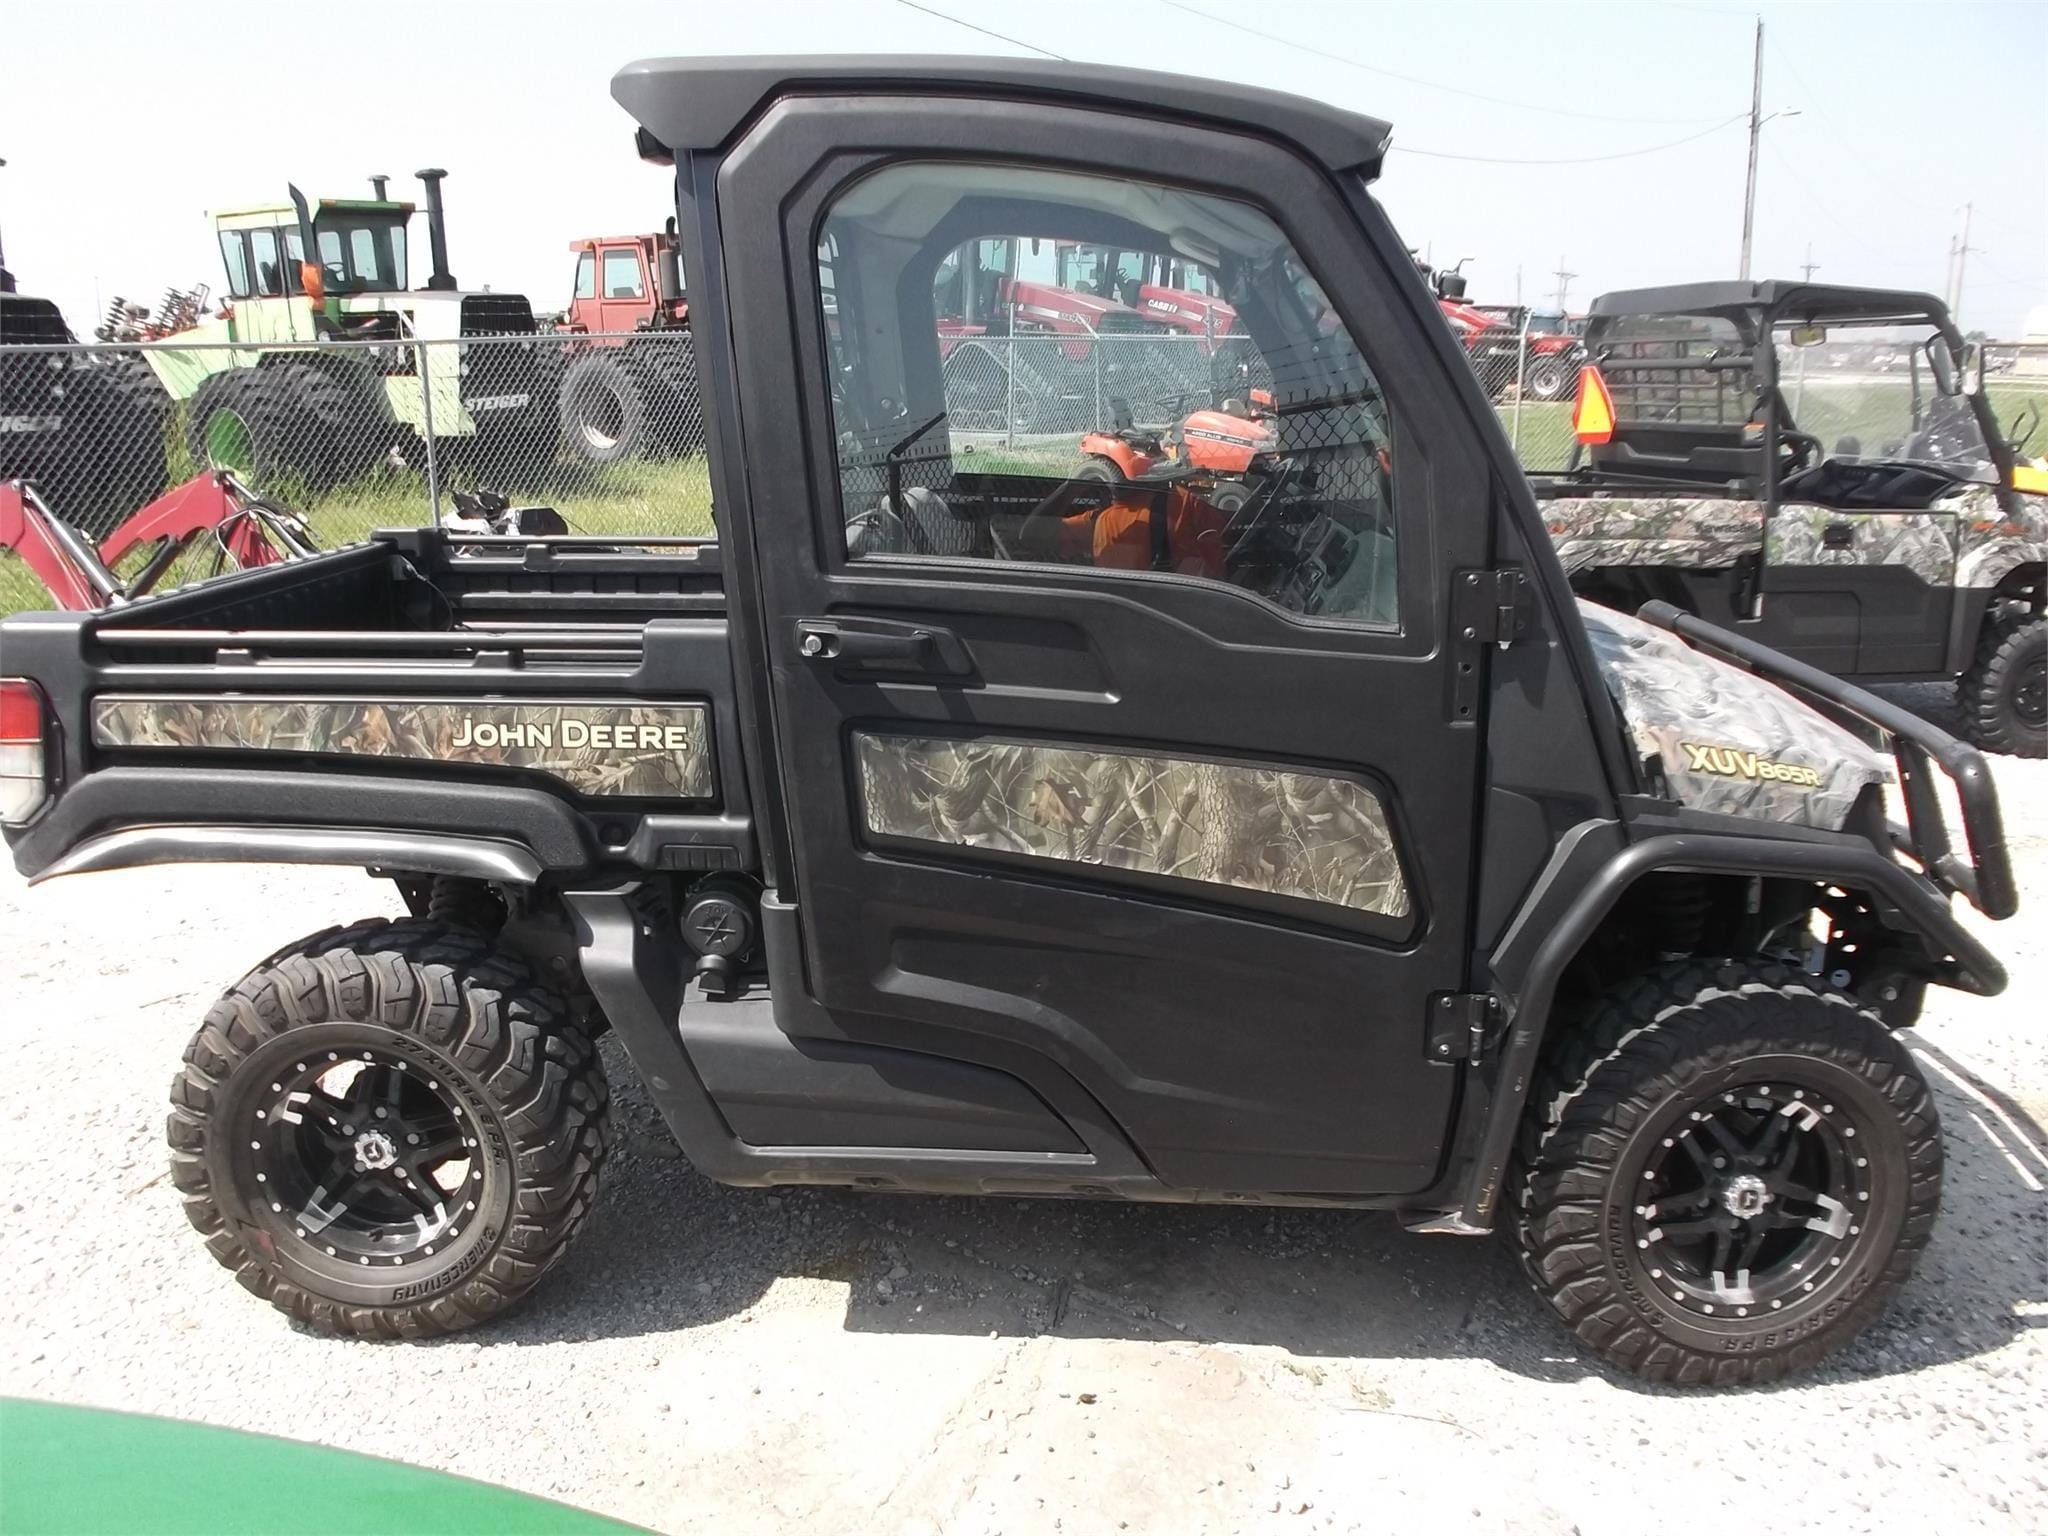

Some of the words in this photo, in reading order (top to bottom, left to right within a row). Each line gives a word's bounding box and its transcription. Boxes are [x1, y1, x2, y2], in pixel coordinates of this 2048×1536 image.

[1148, 299, 1169, 312] CASE
[464, 394, 530, 412] STEIGER
[452, 717, 553, 749] JOHN
[559, 718, 688, 750] DEERE
[1681, 742, 1823, 788] XUV865R
[392, 1237, 489, 1301] MERCENARY
